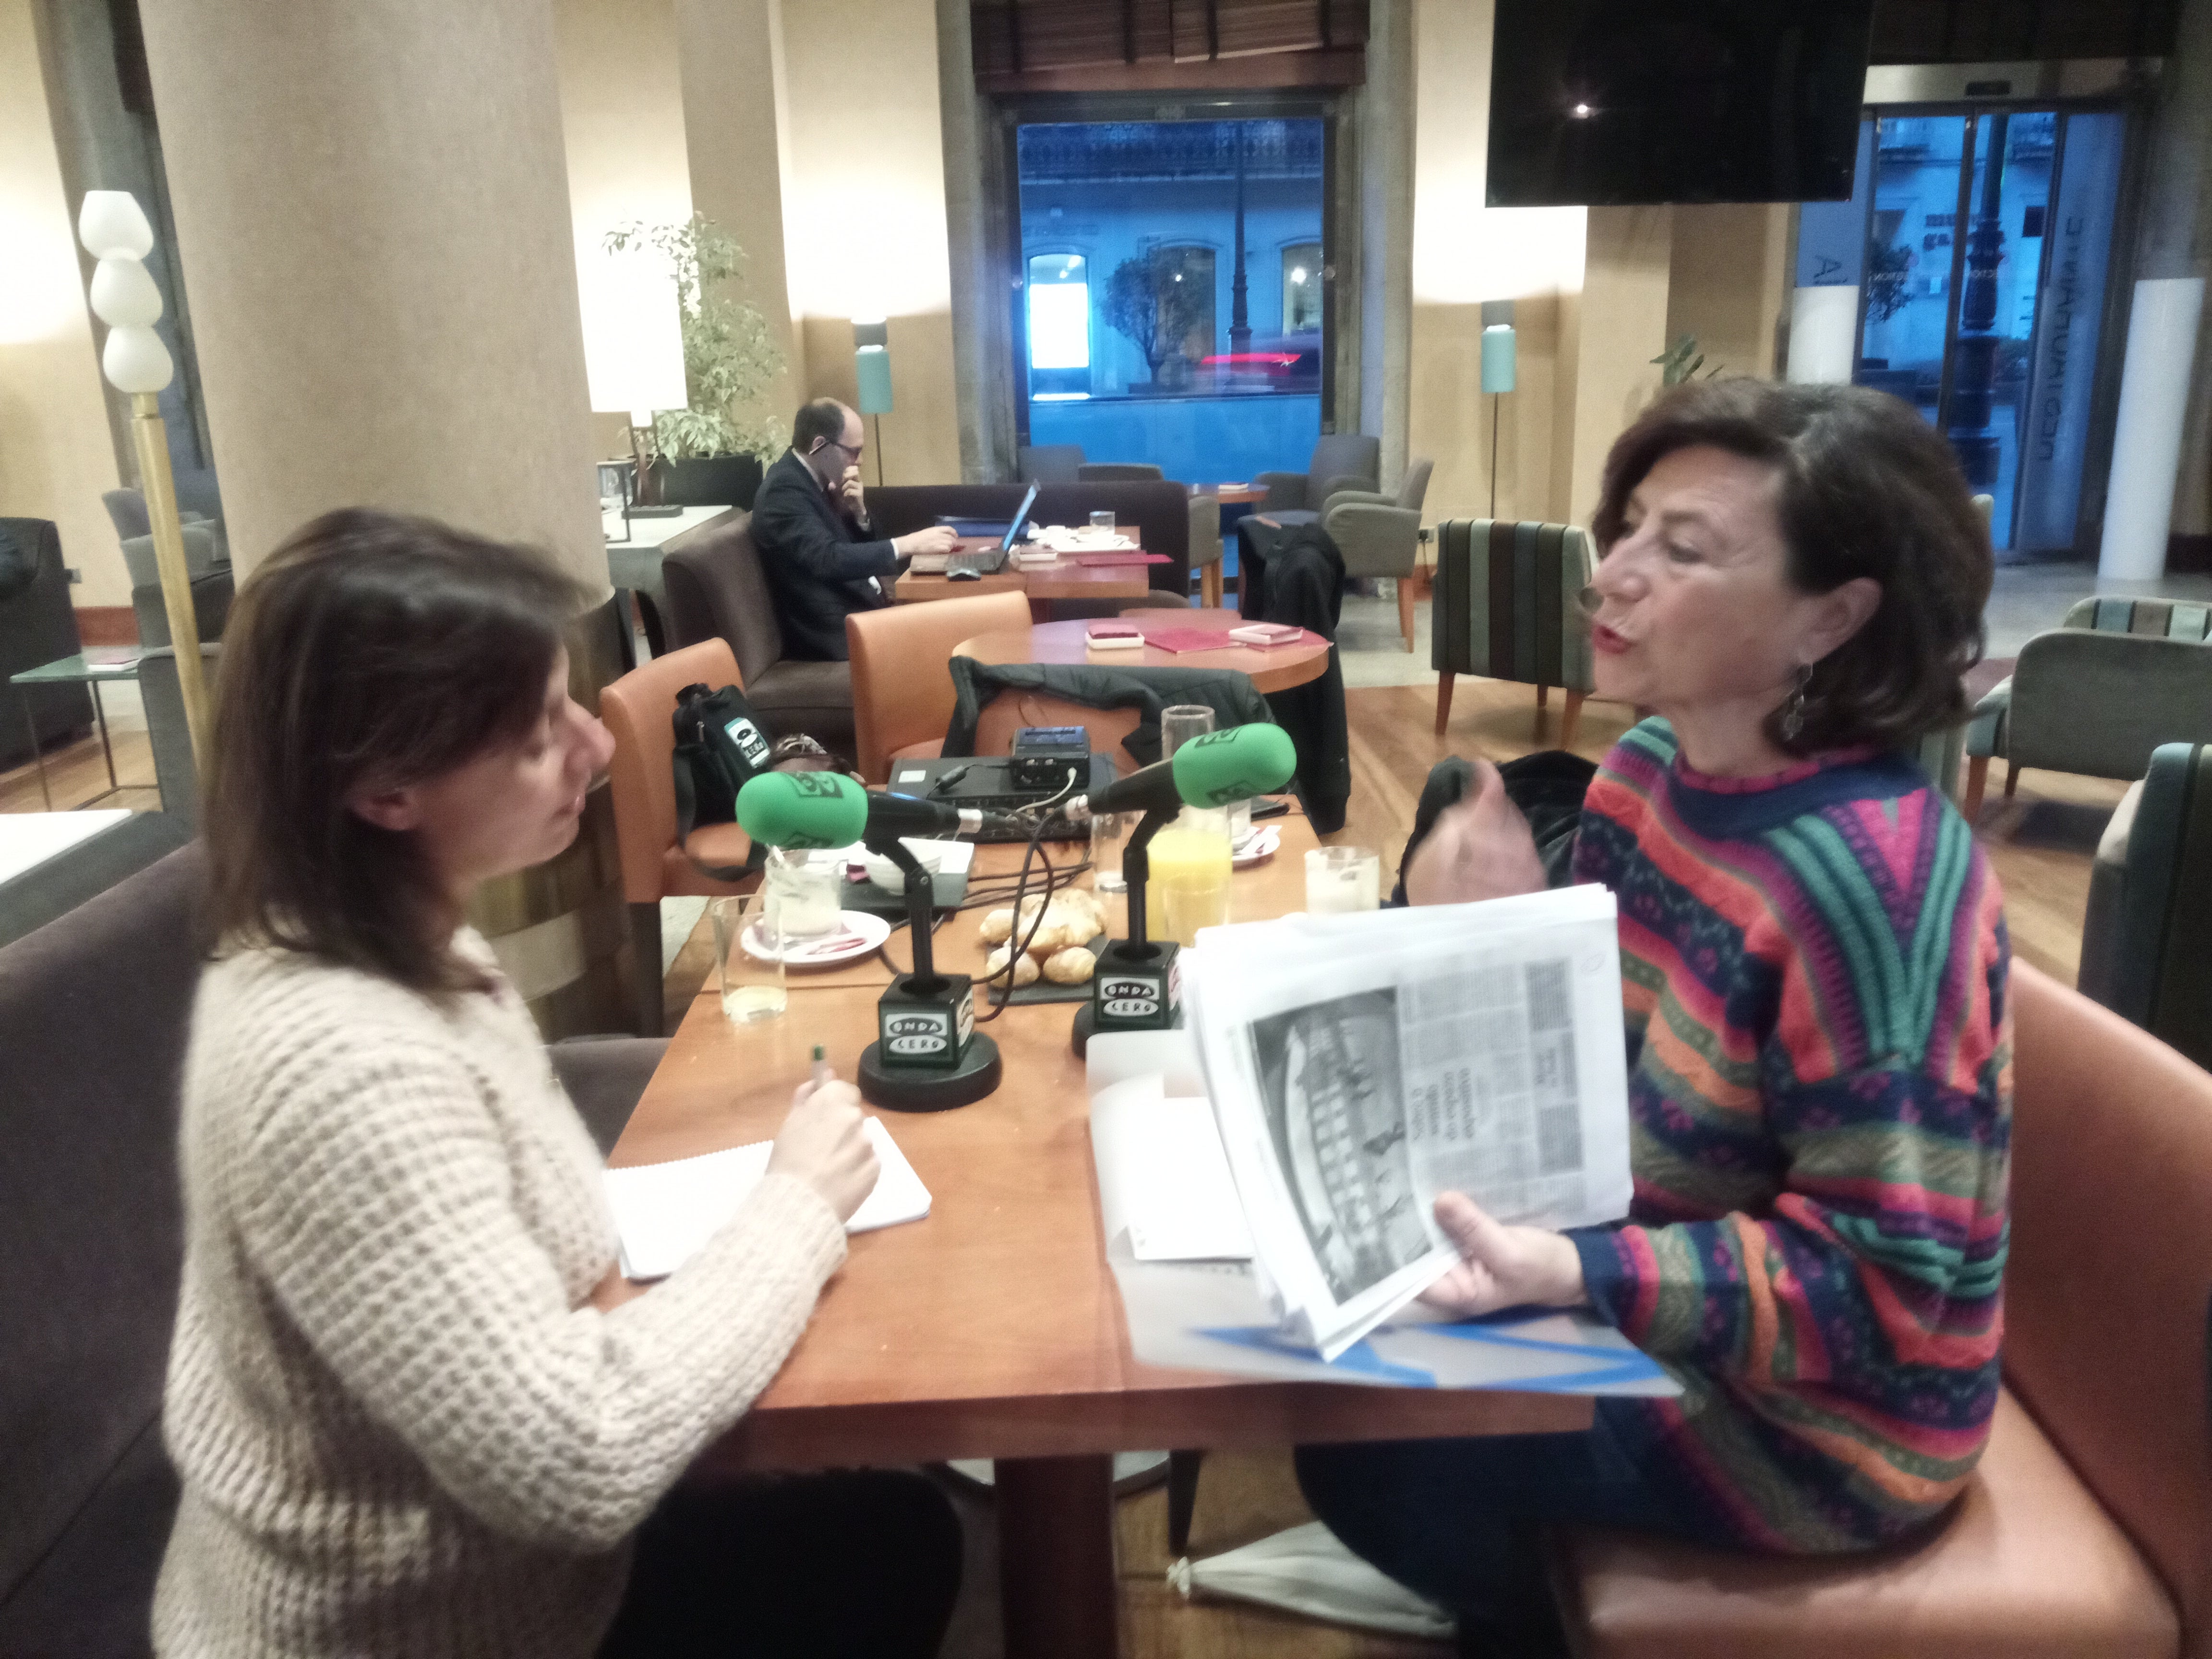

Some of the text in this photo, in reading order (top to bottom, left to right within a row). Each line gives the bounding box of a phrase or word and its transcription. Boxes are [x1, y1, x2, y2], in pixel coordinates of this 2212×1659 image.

[1108, 985, 1152, 996] ONDA
[1112, 1002, 1152, 1012] CERO
[893, 1021, 939, 1033] ONDA
[898, 1039, 939, 1049] CERO
